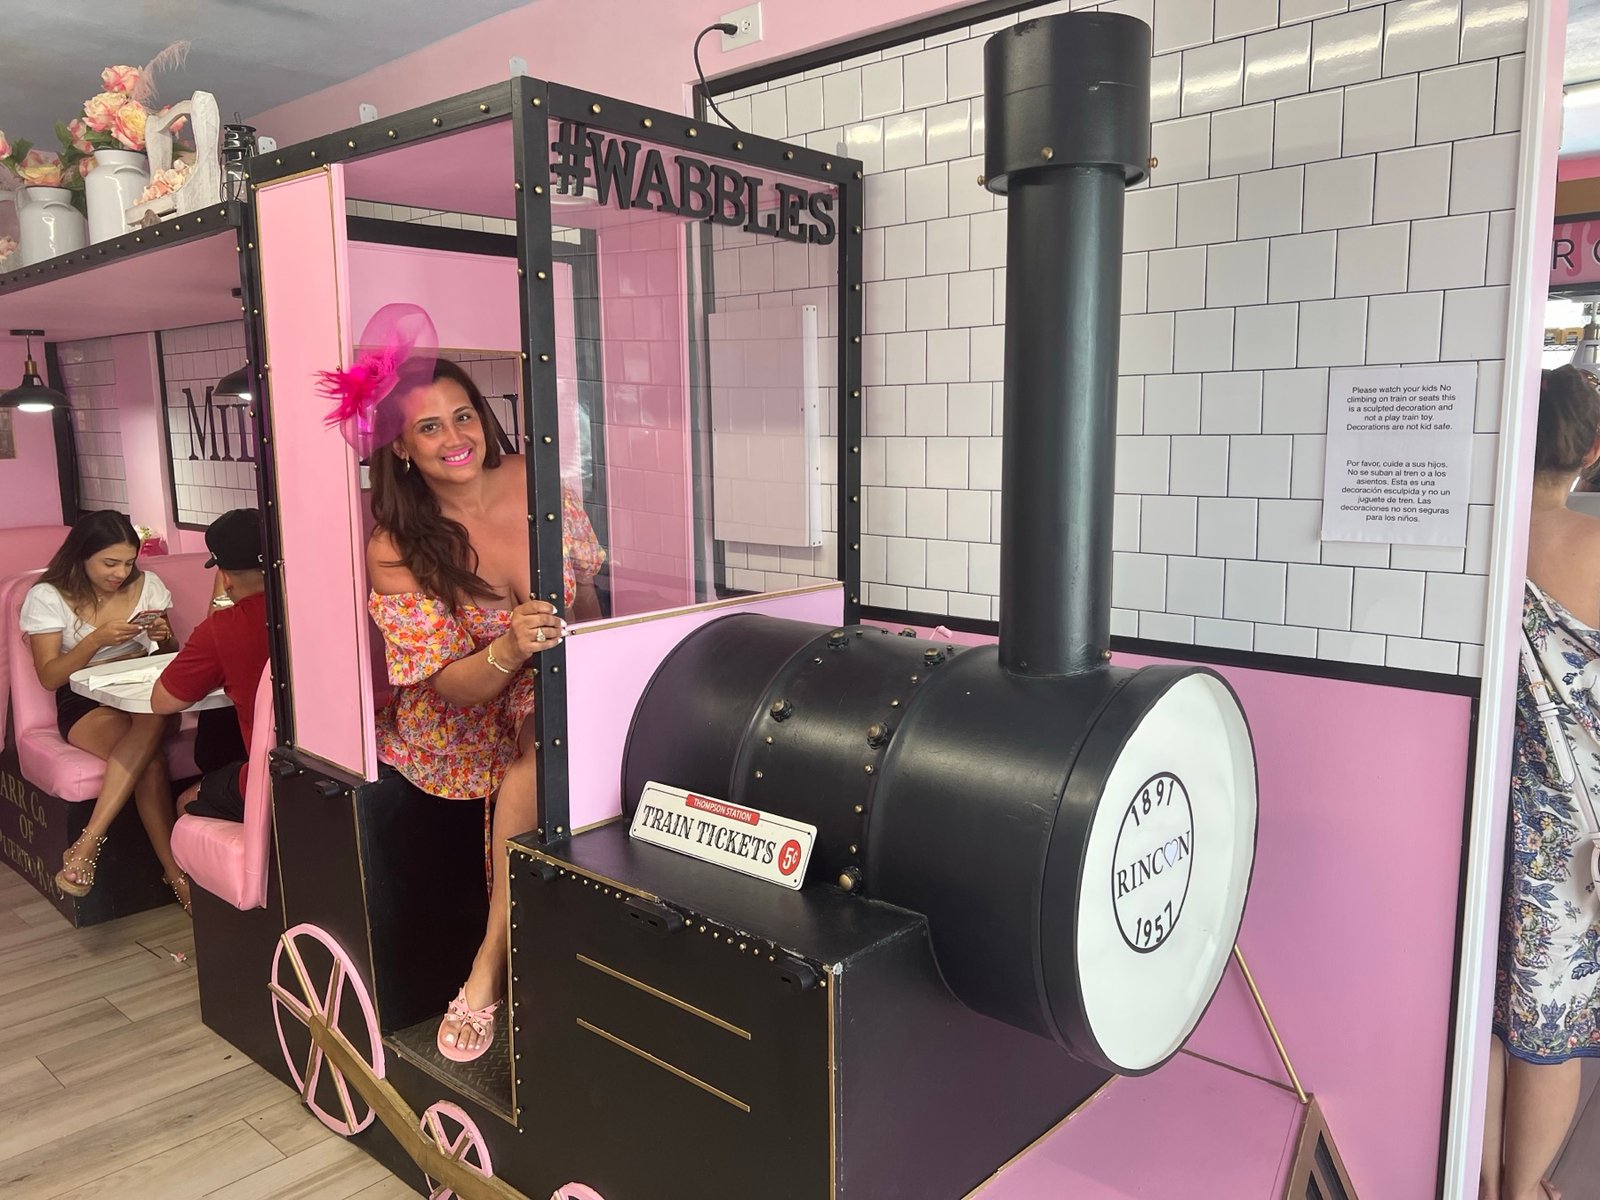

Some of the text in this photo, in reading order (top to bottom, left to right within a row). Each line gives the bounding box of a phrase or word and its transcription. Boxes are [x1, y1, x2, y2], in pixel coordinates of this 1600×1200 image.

[551, 121, 837, 245] #WABBLES
[1352, 384, 1452, 394] Please watch your kids No
[1346, 395, 1377, 404] climbing
[1390, 394, 1407, 402] train
[1418, 394, 1440, 402] seats
[1441, 393, 1456, 401] this
[1362, 404, 1394, 414] sculpted
[1396, 403, 1436, 412] decoration
[1437, 403, 1454, 412] and
[1384, 414, 1400, 422] play
[1346, 423, 1390, 431] Decorations
[1420, 422, 1432, 430] kid
[1433, 422, 1453, 430] safe.
[1346, 460, 1359, 468] Por
[1360, 460, 1382, 468] favor,
[1382, 460, 1404, 468] cuide
[1427, 460, 1448, 470] hijos.
[1347, 468, 1358, 476] No
[1370, 469, 1394, 477] suban
[1434, 470, 1447, 478] los
[1356, 478, 1390, 486] asientos.
[1391, 478, 1408, 486] Esta
[1341, 486, 1382, 494] decoración
[1383, 487, 1420, 497] esculpida
[1421, 489, 1427, 497] y
[1357, 496, 1386, 504] juguete
[1398, 496, 1415, 504] tren.
[1417, 496, 1432, 505] Las
[1340, 504, 1390, 512] decoraciones
[1418, 508, 1450, 516] seguras
[1365, 514, 1420, 523] para los niños.
[1131, 779, 1174, 827] 1891
[693, 797, 752, 822] THOMPSON STATION
[19, 814, 33, 844] OF
[642, 804, 776, 864] TRAIN TICKETS
[782, 846, 799, 870] 5¢
[1134, 899, 1173, 947] 1957
